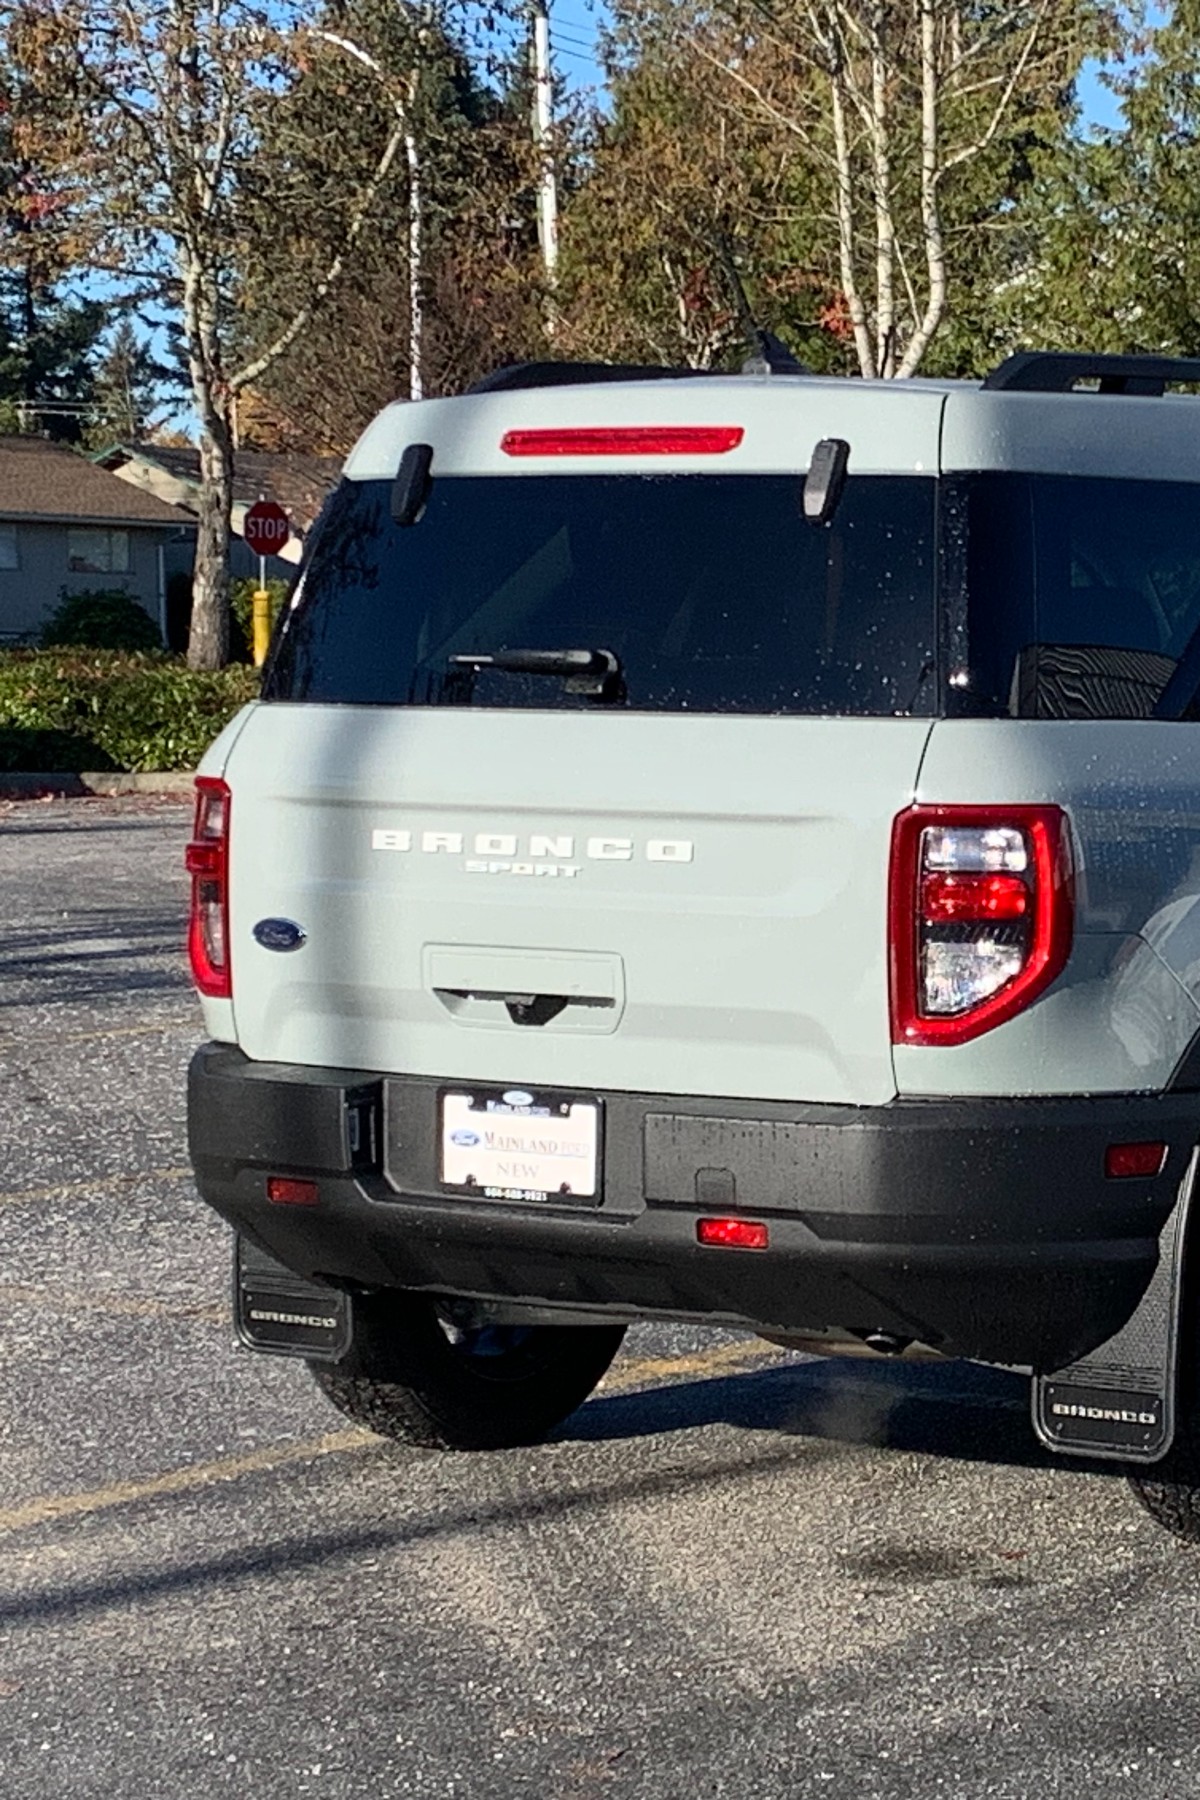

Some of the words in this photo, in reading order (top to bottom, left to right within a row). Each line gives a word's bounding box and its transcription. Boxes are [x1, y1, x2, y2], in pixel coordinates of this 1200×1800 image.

[248, 519, 285, 538] STOP
[372, 829, 694, 862] BRONCO
[466, 861, 582, 877] SPORT
[497, 1162, 540, 1179] NEW
[251, 1310, 337, 1328] BRONCO
[1052, 1403, 1156, 1424] BRONCO
